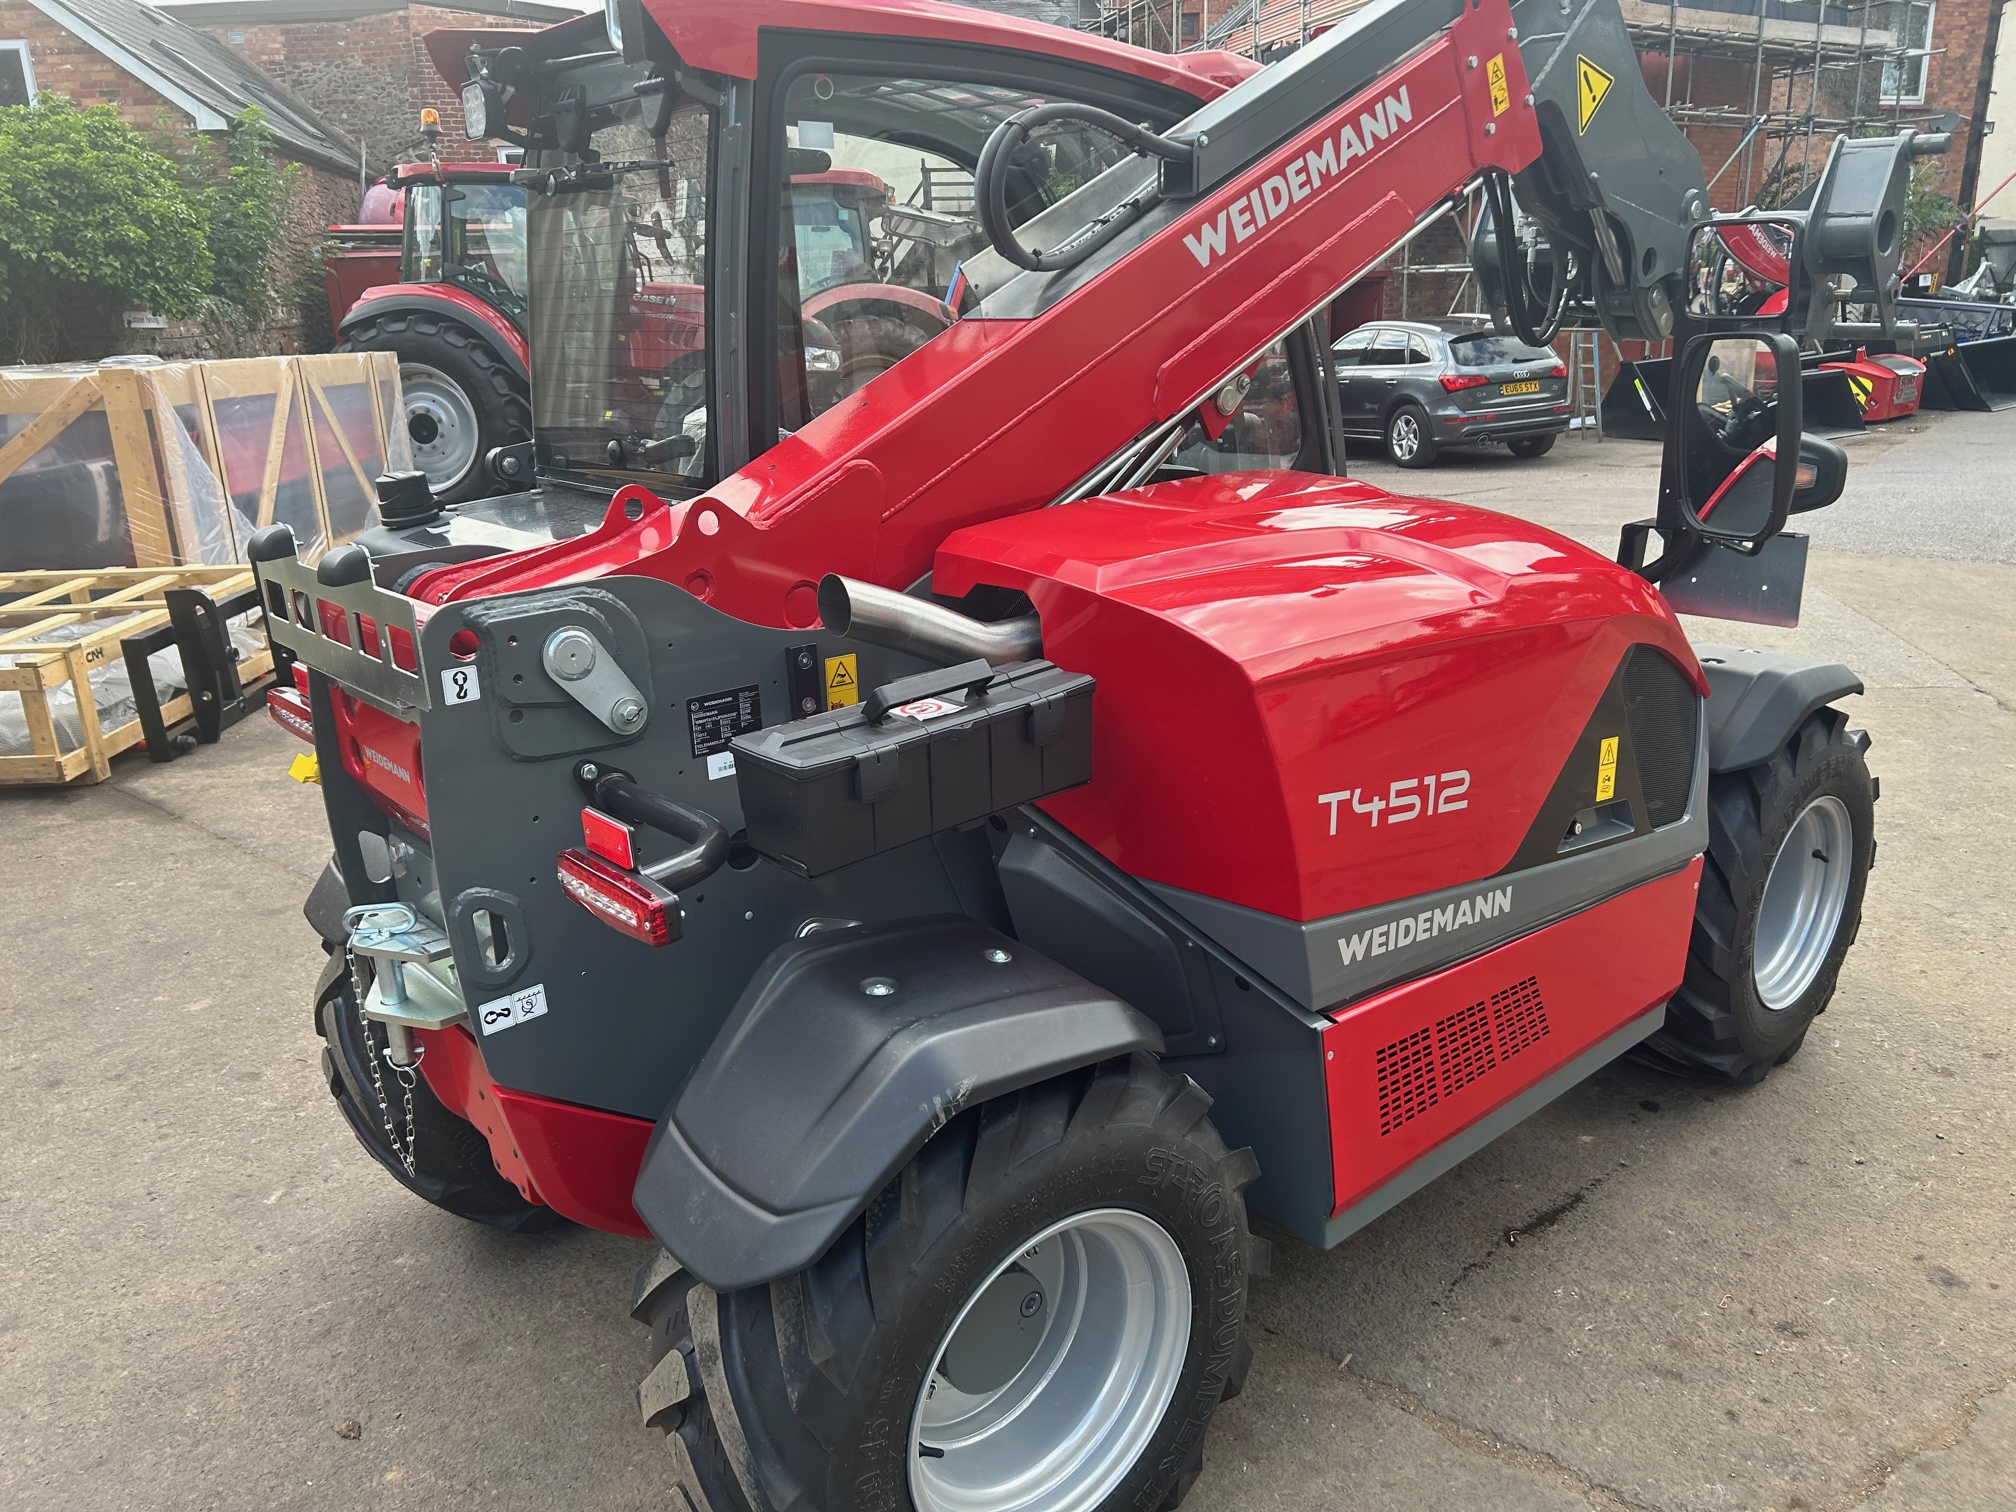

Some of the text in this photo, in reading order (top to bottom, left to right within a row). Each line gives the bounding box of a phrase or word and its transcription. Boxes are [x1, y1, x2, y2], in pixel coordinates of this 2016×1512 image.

[1182, 84, 1413, 268] WEIDEMANN
[633, 293, 664, 304] CASE
[1504, 382, 1538, 393] EU65 STX
[86, 646, 104, 663] CNH
[363, 744, 411, 784] WEIDEMANN
[1318, 769, 1471, 836] T4512
[1337, 885, 1513, 966] WEIDEMANN
[1209, 1227, 1241, 1288] AS
[1159, 1287, 1242, 1477] DUMPER
